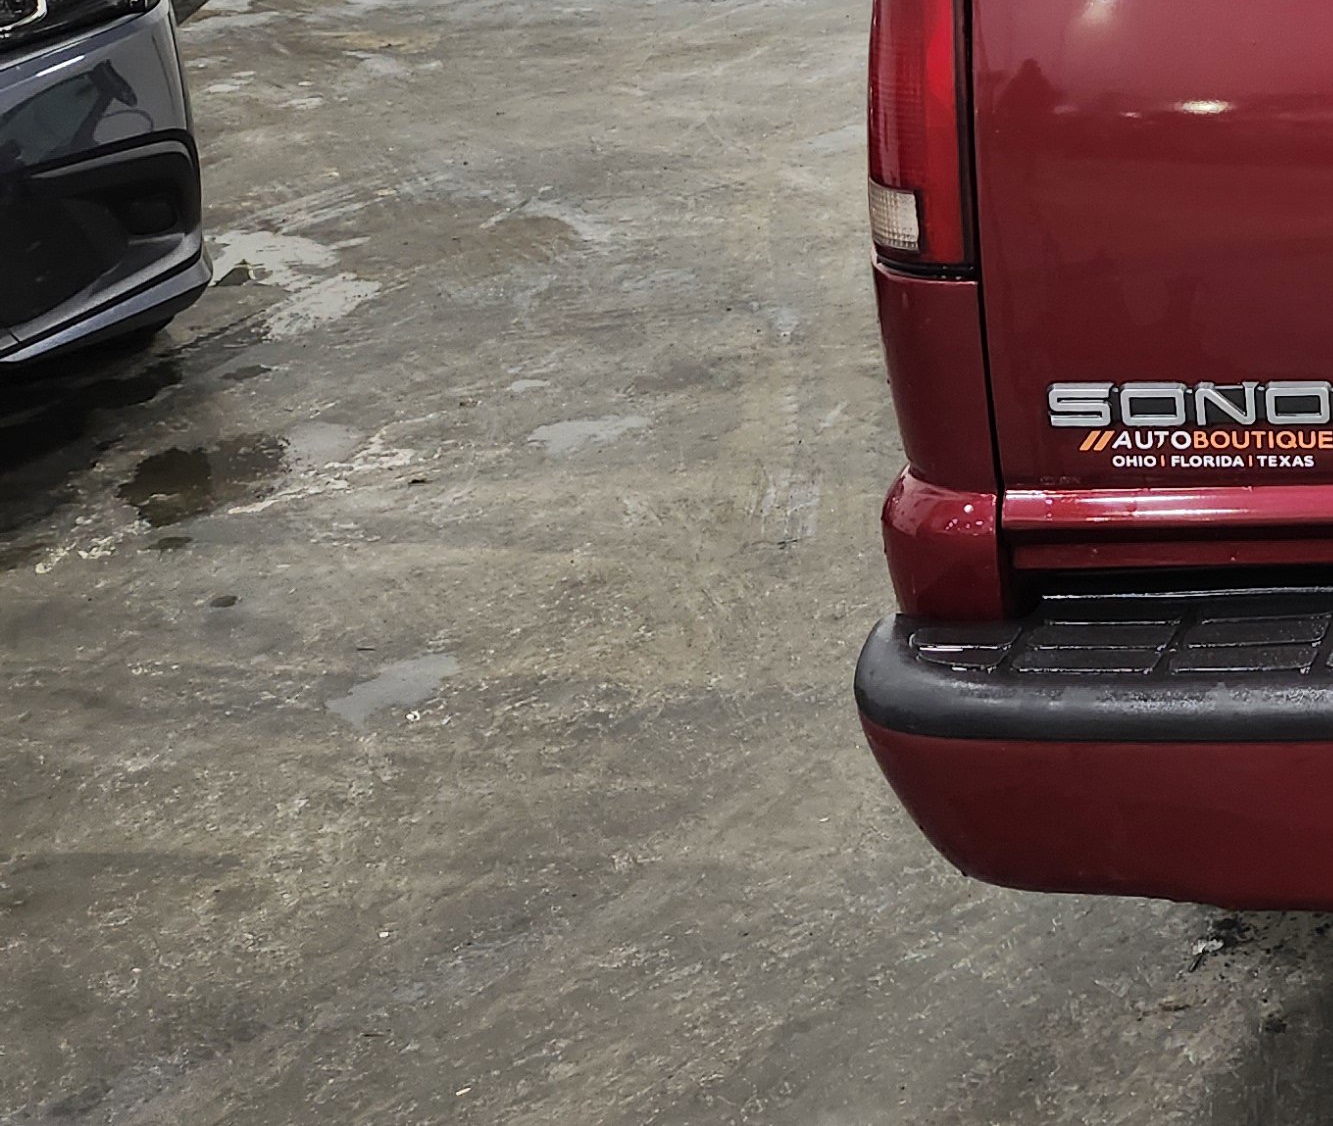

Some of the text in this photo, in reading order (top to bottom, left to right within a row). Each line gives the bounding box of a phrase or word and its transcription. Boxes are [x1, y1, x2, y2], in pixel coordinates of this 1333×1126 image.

[1112, 454, 1157, 468] OHIO
[1171, 454, 1245, 468] FLORIDA
[1256, 454, 1315, 468] TEXAS
